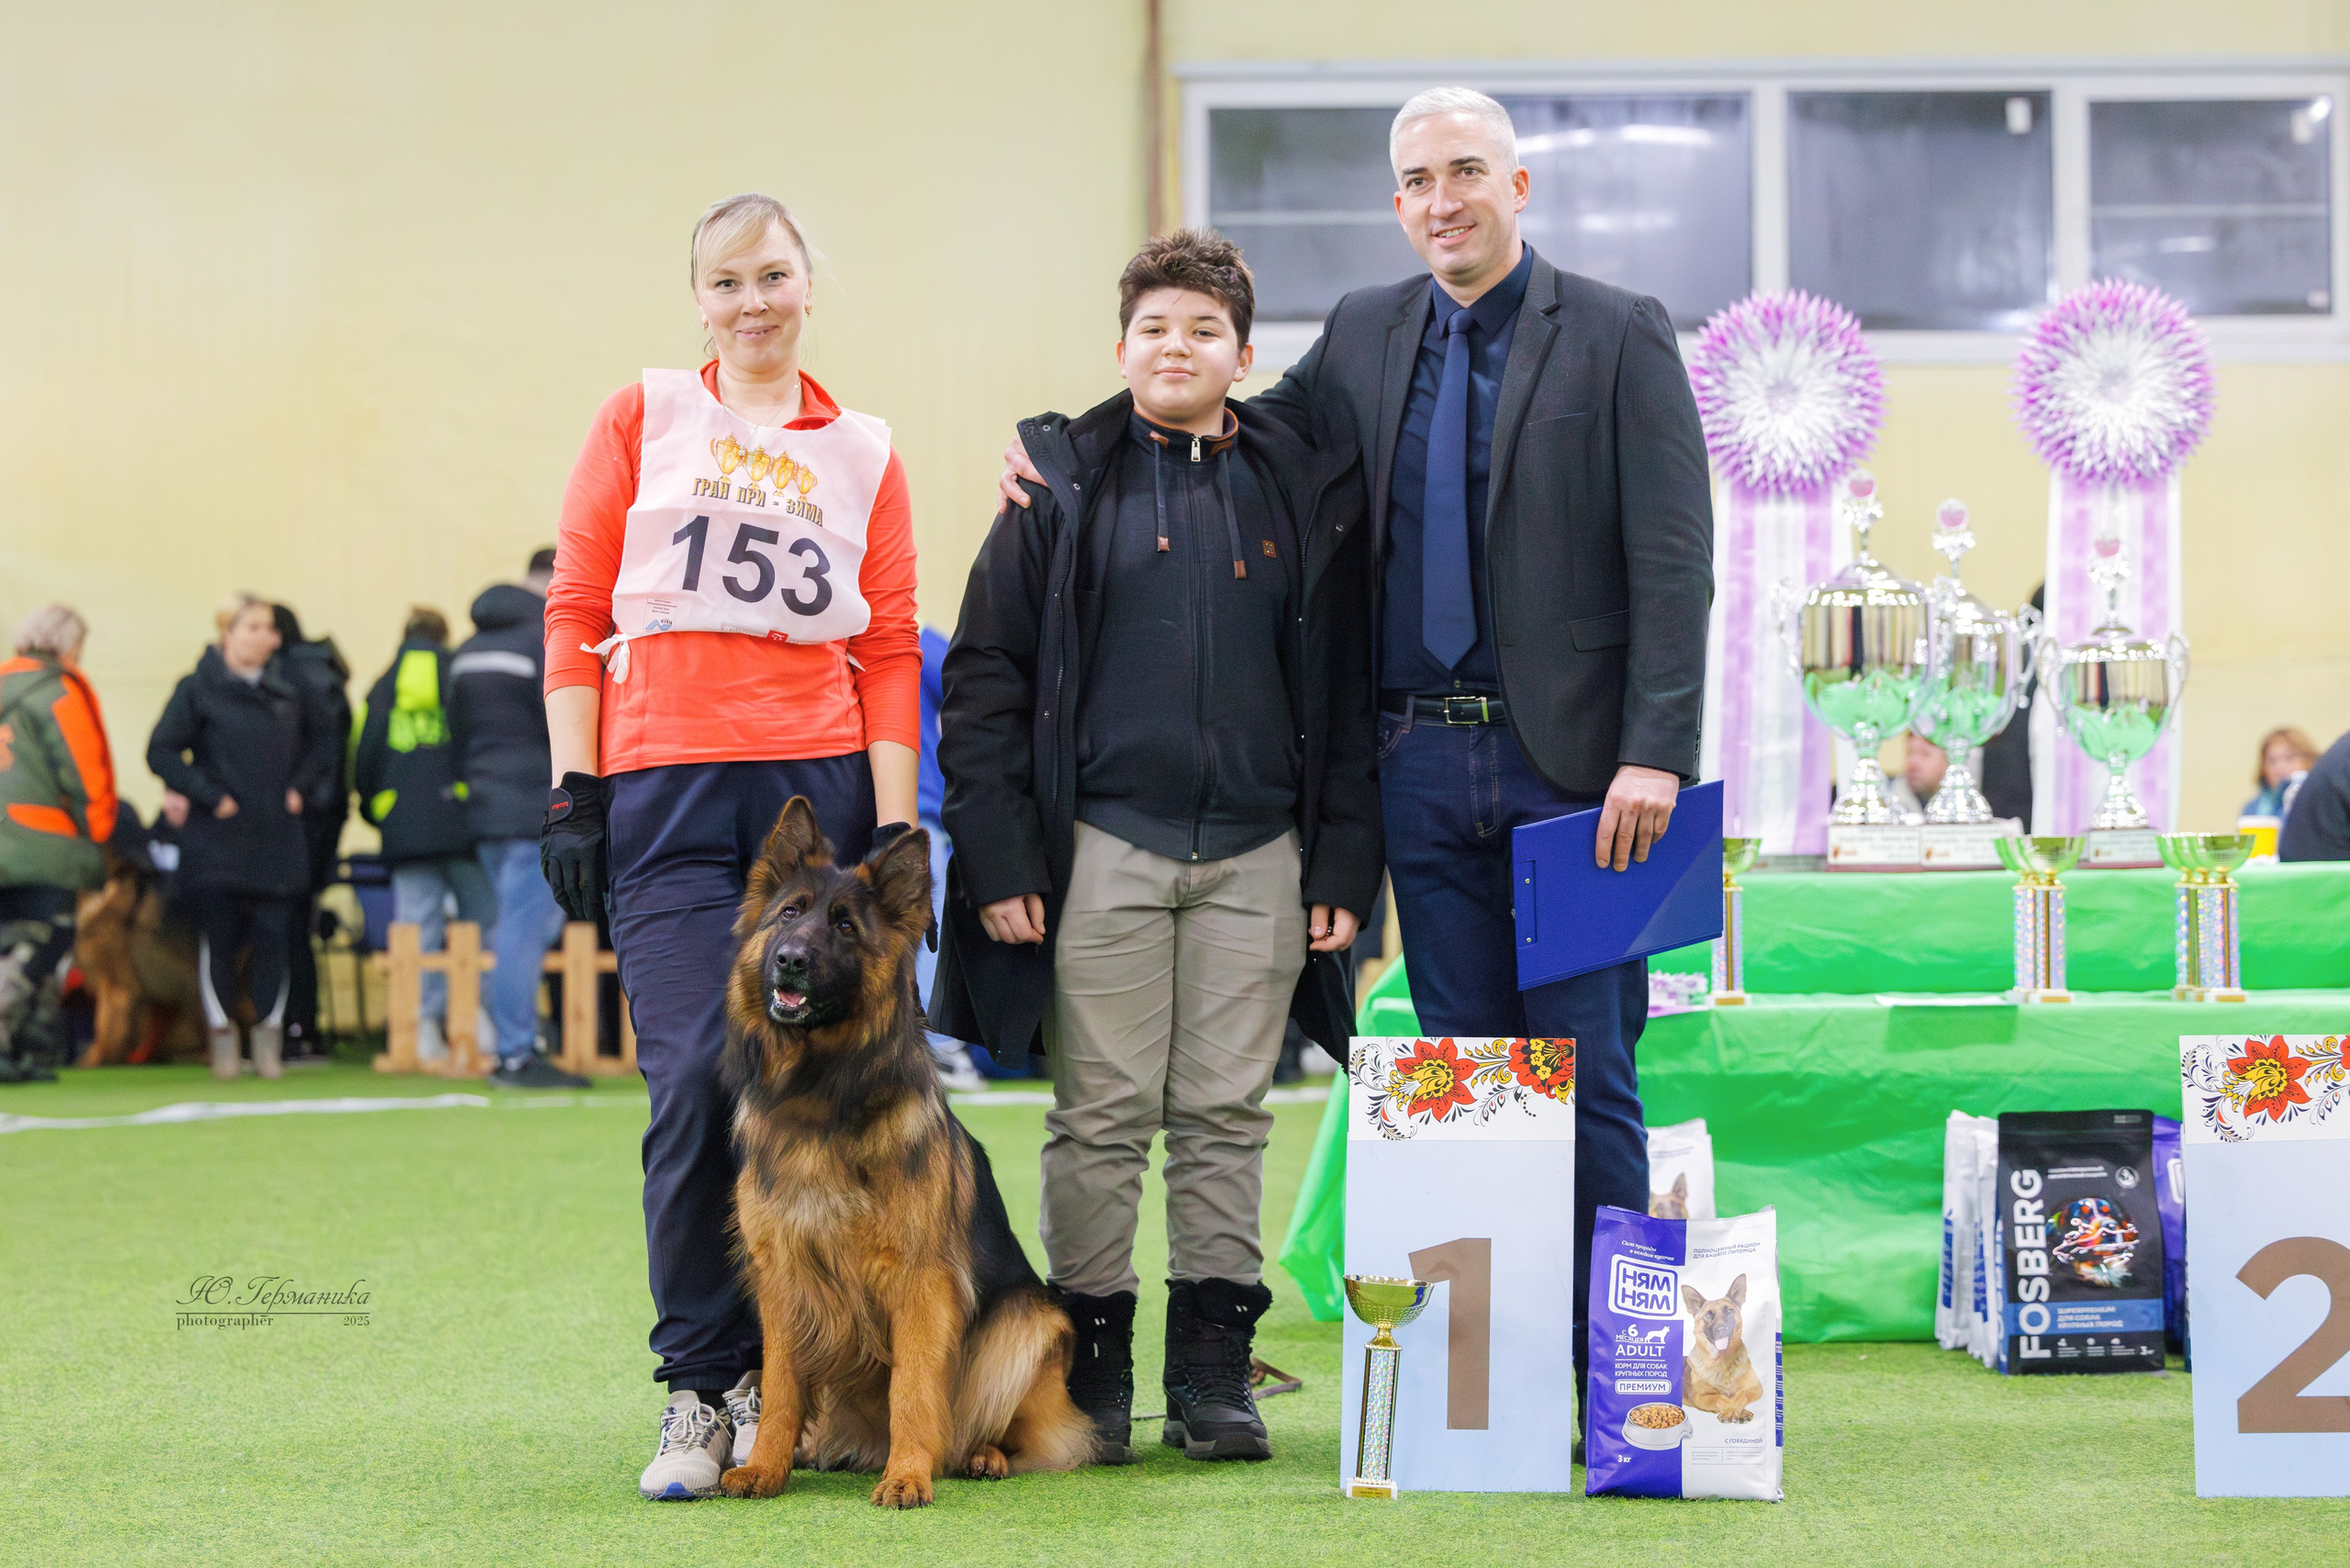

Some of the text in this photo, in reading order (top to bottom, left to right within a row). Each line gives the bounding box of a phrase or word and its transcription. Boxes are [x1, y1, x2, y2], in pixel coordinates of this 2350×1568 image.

[692, 477, 731, 500] ГРАН
[736, 487, 767, 508] ПРИ
[785, 498, 823, 527] ЗИМА
[672, 514, 833, 617] 153
[1693, 1243, 1737, 1254] ПОЛНОЦЕННЫЙ
[2010, 1169, 2052, 1359] FOSBERG
[1622, 1267, 1672, 1293] НЯМ
[1621, 1287, 1671, 1311] НЯМ
[1408, 1238, 1492, 1430] 1
[1616, 1334, 1644, 1343] МЕСЯЦЕВ
[1628, 1323, 1639, 1338] 6
[2235, 1236, 2350, 1434] 2
[1615, 1344, 1665, 1357] ADULT
[1619, 1383, 1666, 1391] ПРЕМИУМ
[1617, 1454, 1623, 1462] 3
